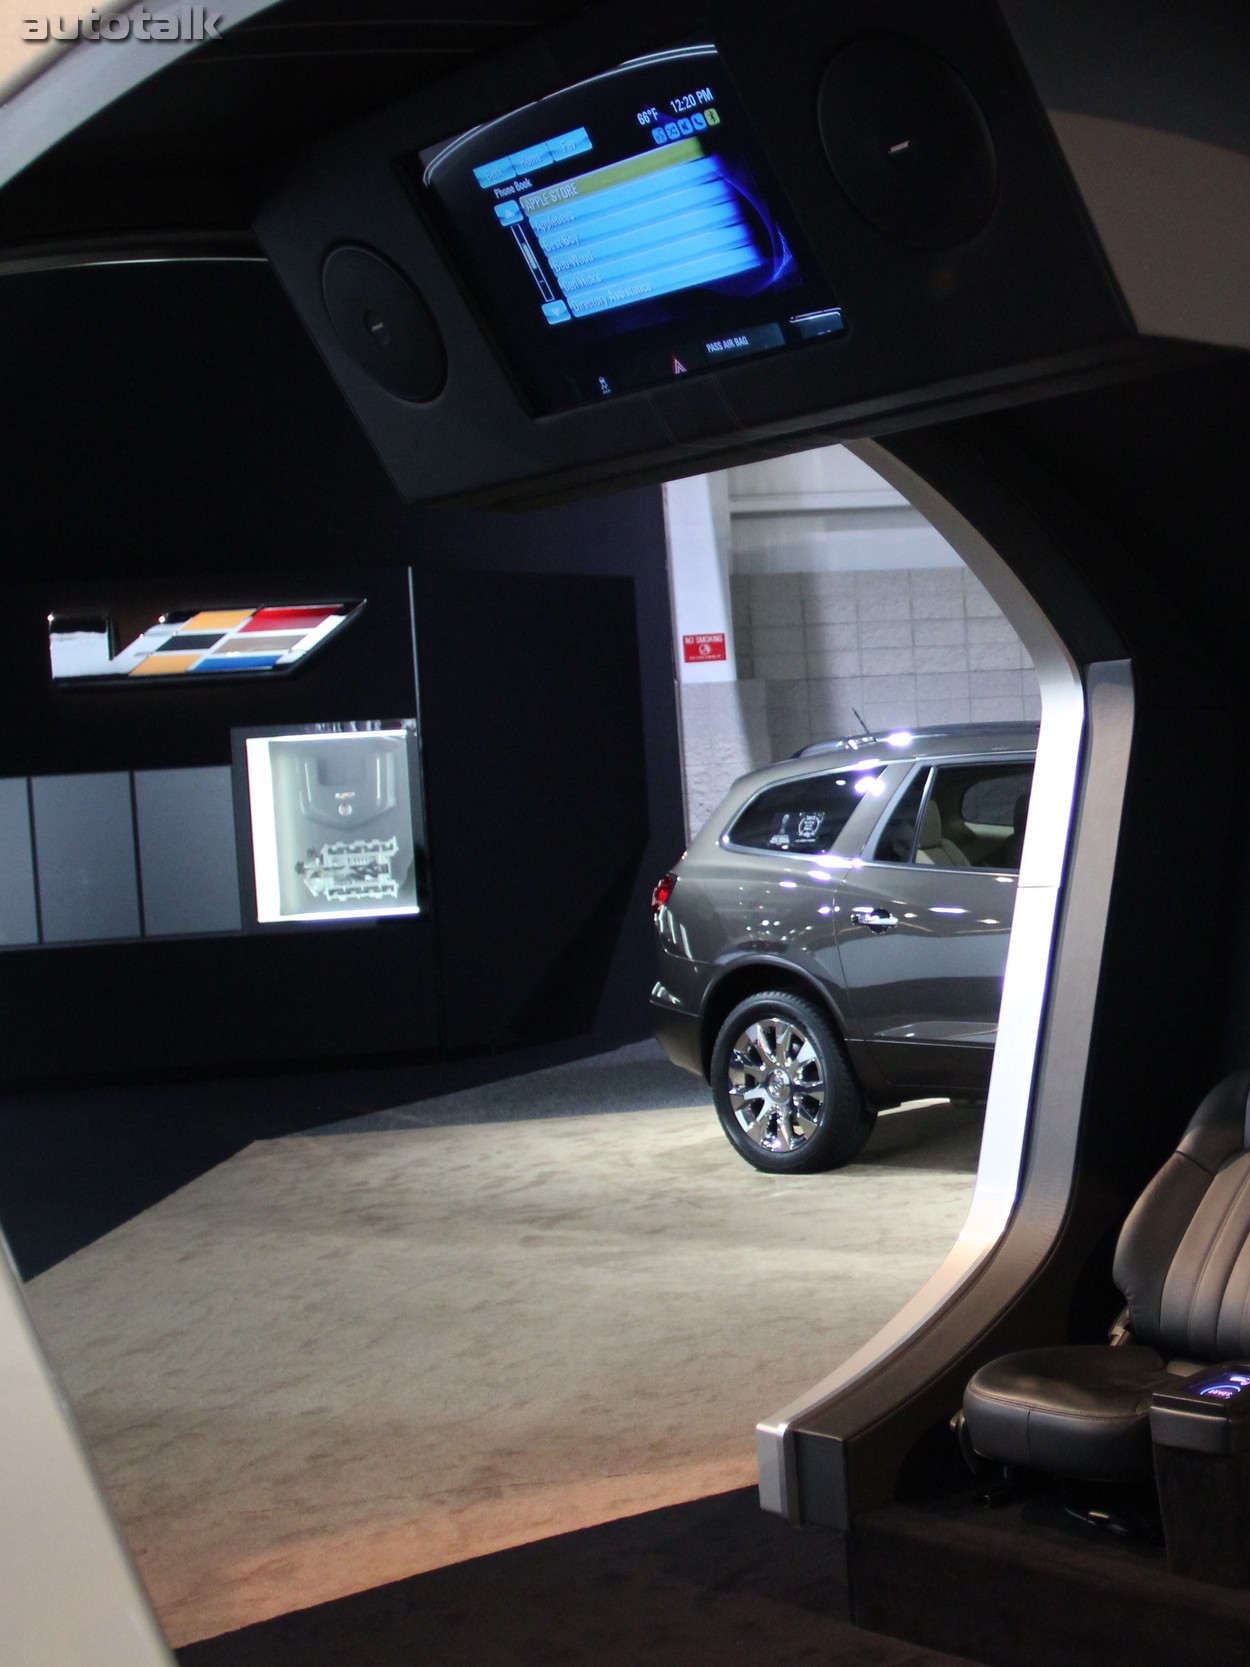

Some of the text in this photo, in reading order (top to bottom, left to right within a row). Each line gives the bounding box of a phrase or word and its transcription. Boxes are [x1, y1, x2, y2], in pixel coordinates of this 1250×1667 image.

[670, 94, 696, 113] 12:20
[695, 87, 714, 104] PM
[493, 176, 533, 199] Phone Book
[525, 182, 580, 212] APPLE STORE
[543, 230, 581, 252] Best Buy
[571, 281, 654, 312] Directory Assistance
[706, 335, 749, 353] PASS AIR BAG
[684, 635, 722, 644] NO SMOKING
